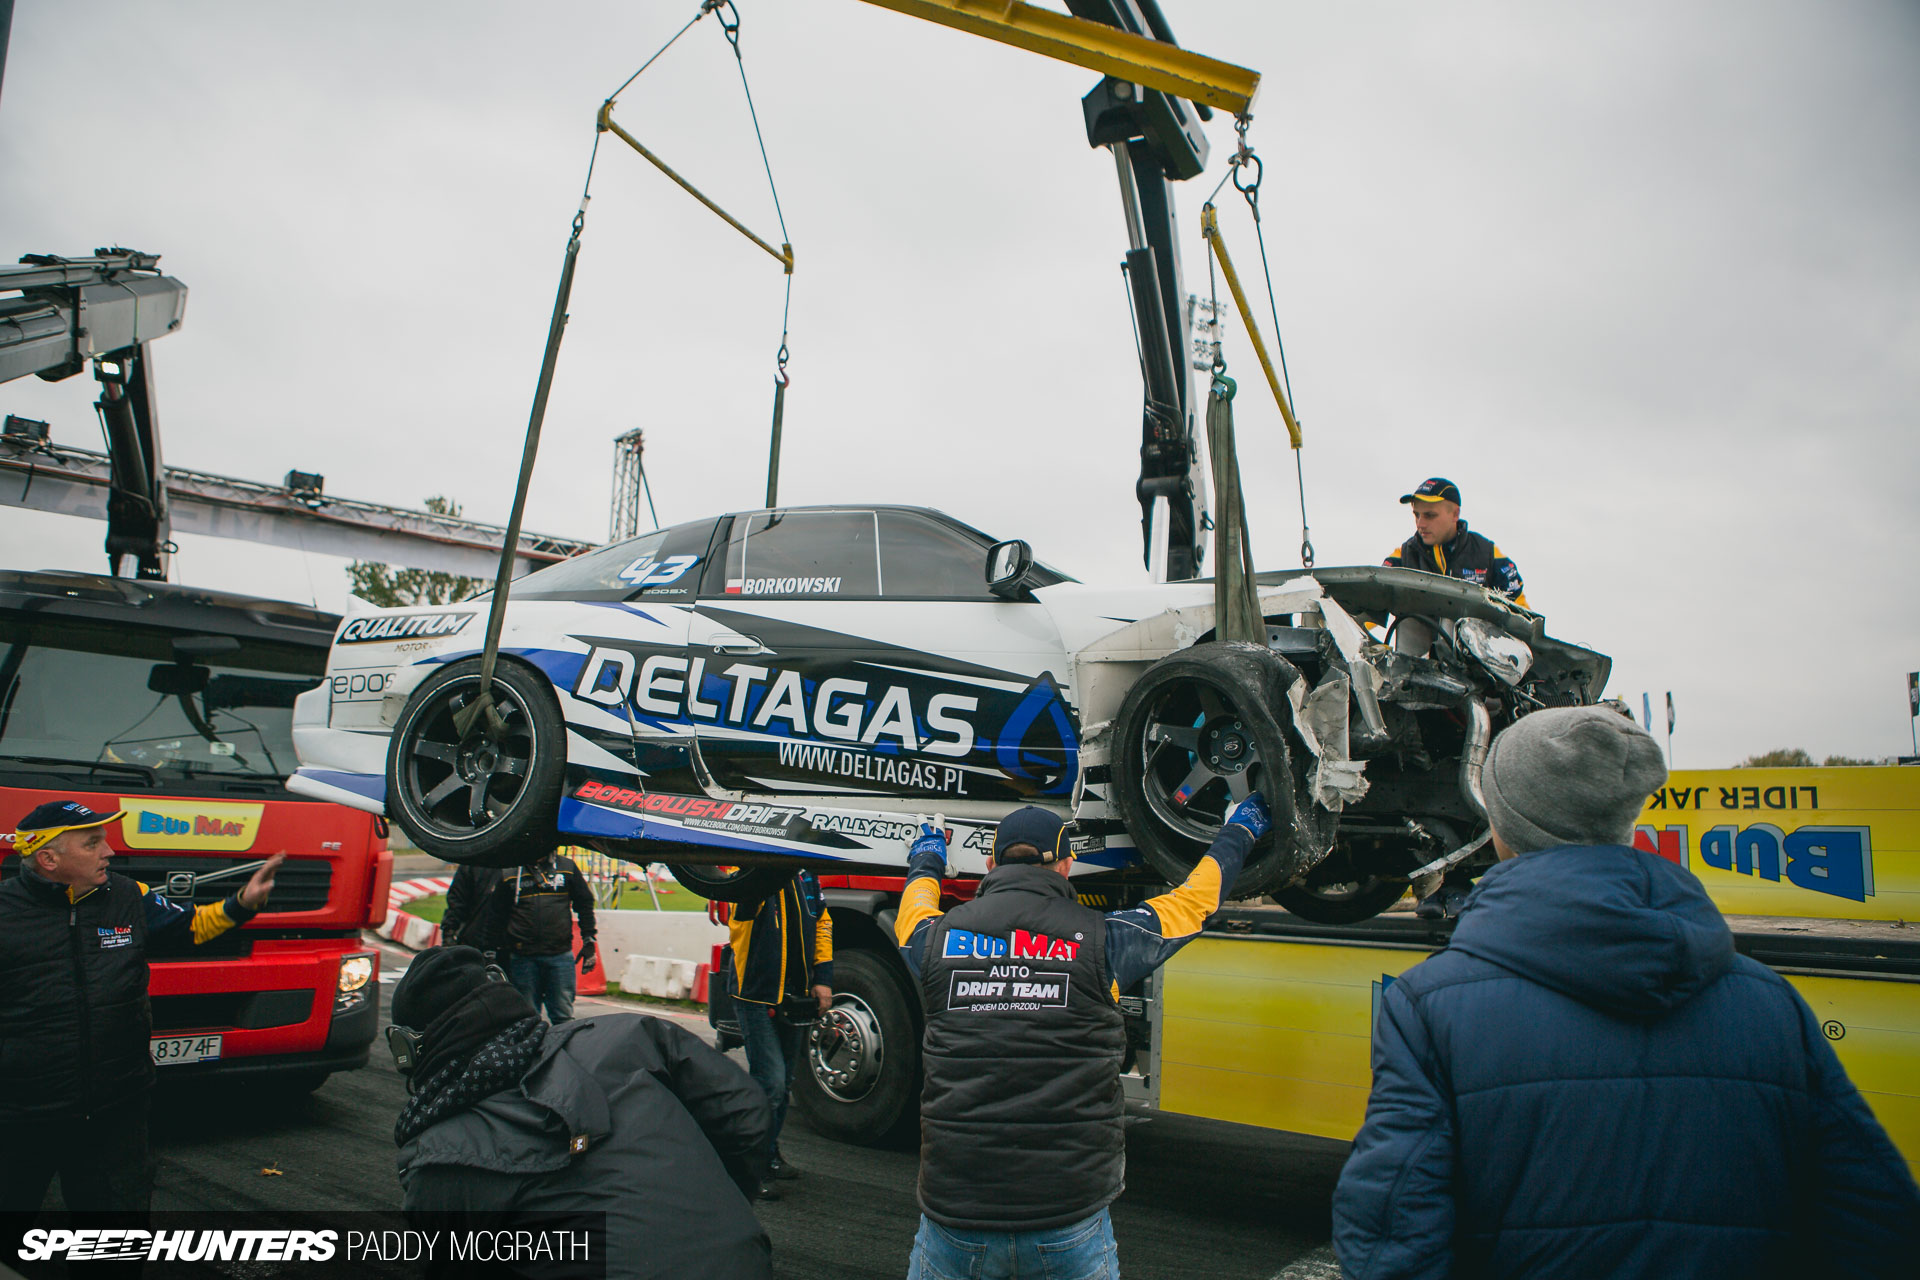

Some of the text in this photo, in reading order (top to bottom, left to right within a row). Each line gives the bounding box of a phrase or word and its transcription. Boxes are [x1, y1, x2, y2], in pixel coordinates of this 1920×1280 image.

[617, 554, 699, 587] 43
[744, 577, 841, 594] BORKOWSKI
[576, 646, 979, 757] DELTAGAS
[779, 742, 967, 795] WWW.DELTAGAS.PL
[1719, 786, 1818, 809] LIDER
[138, 811, 245, 836] BUD MAT
[1700, 822, 1876, 903] BUD
[942, 928, 1008, 959] BUD
[1010, 928, 1081, 961] MAT
[989, 965, 1030, 978] AUTO
[956, 981, 1060, 998] DRIFT TEAM
[971, 1004, 997, 1012] BOKIEM
[1010, 1003, 1041, 1011] PRZODU
